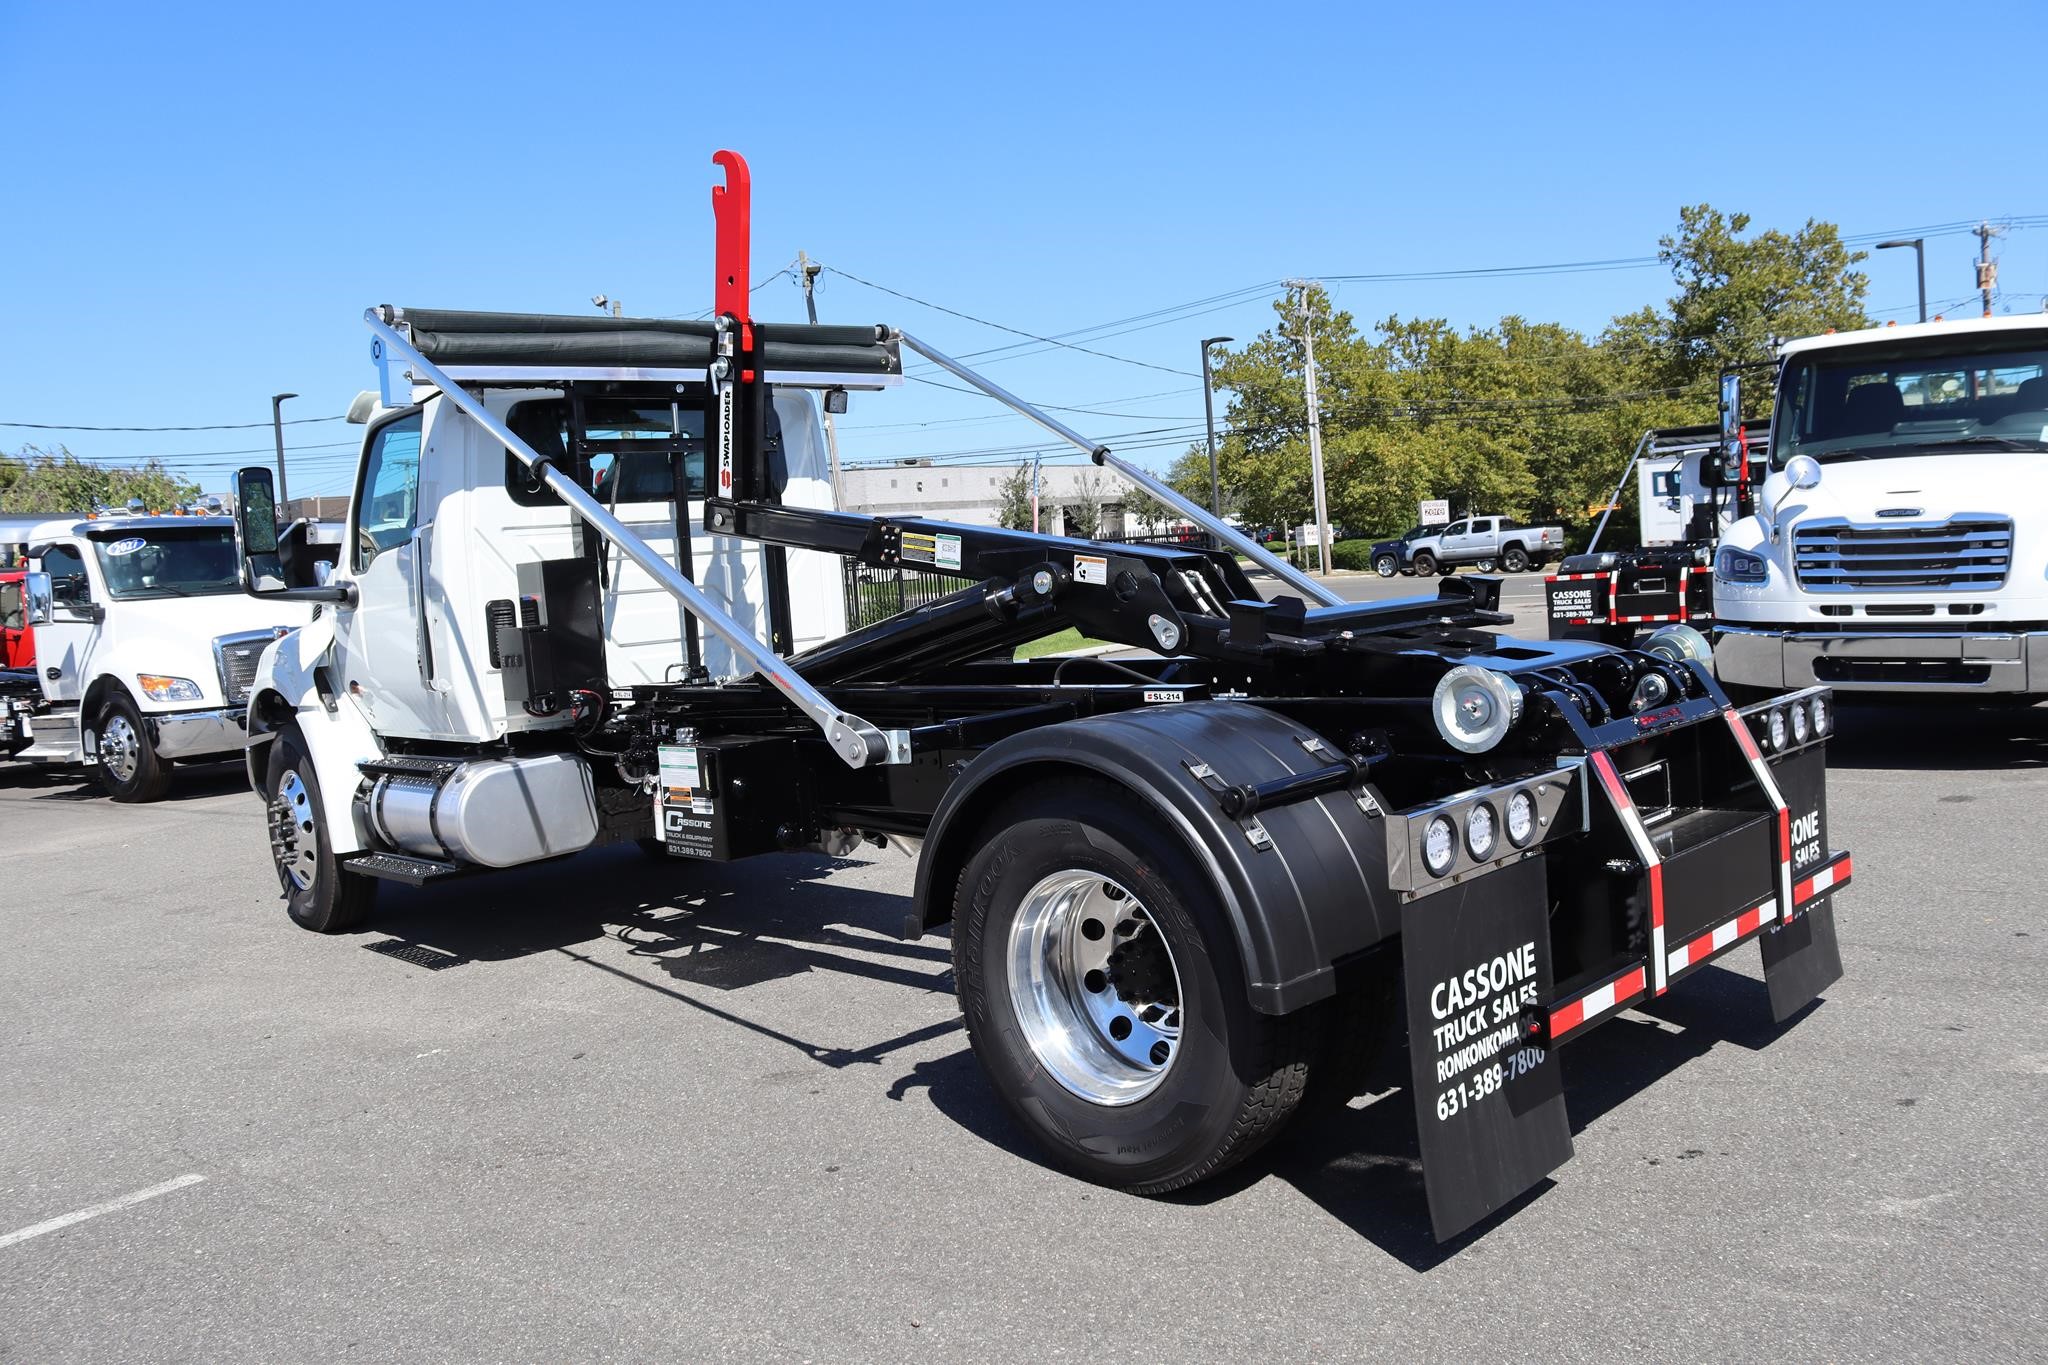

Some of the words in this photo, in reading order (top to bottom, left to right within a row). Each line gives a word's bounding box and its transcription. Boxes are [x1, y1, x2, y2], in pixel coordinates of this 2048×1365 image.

[723, 391, 731, 467] SWAPLOADER
[1552, 590, 1592, 599] CASSONE
[1552, 610, 1594, 618] 631-389-7800
[666, 811, 712, 831] CASSONE
[1795, 840, 1820, 868] SALES
[1431, 942, 1537, 1019] CASSONE
[1433, 1005, 1488, 1052] TRUCK
[1493, 981, 1538, 1023] SALES
[1437, 1049, 1545, 1121] 631-389-7800
